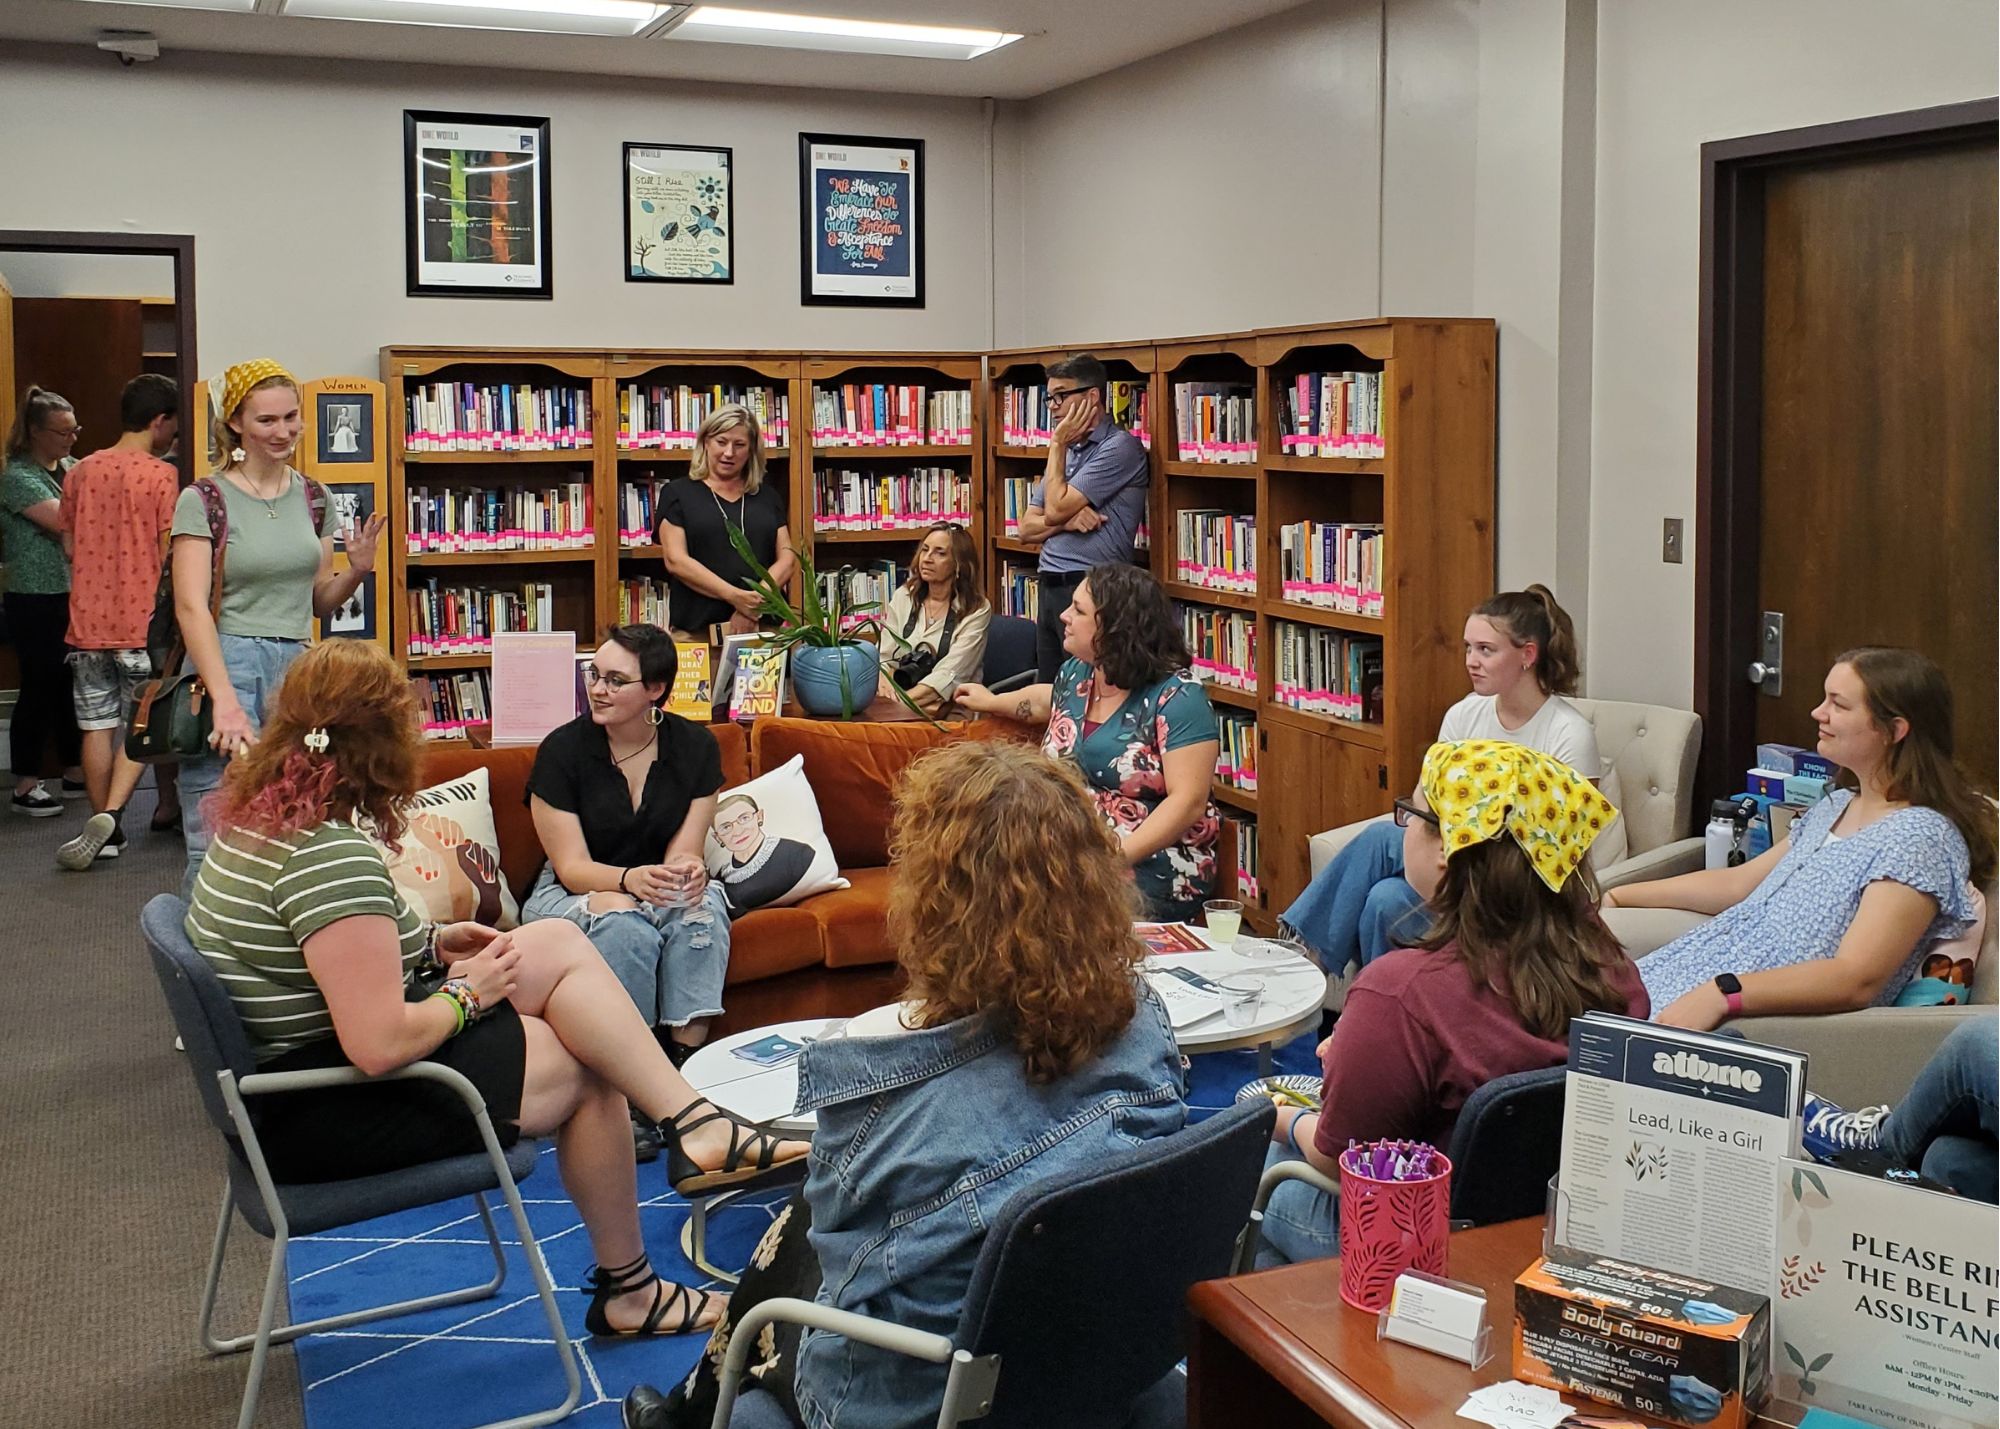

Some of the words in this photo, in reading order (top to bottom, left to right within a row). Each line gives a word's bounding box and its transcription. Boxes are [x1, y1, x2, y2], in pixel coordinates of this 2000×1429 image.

[436, 130, 459, 140] WORLD
[635, 176, 654, 185] Still
[829, 177, 850, 193] We
[850, 179, 880, 196] Have
[878, 181, 897, 196] To
[830, 190, 874, 208] Embrace
[874, 194, 898, 209] Our
[826, 204, 882, 221] Differences
[881, 207, 899, 221] To
[824, 217, 857, 232] Create
[857, 217, 902, 235] Freedom
[838, 231, 894, 249] Acceptance
[842, 245, 863, 260] For
[322, 379, 367, 390] WOMEN
[736, 674, 778, 692] BOY
[740, 698, 776, 713] AND
[1804, 763, 1826, 773] KNOW
[447, 782, 477, 801] UP
[1652, 1051, 1762, 1093] attune
[1629, 1107, 1673, 1133] Lead,
[1680, 1118, 1713, 1139] Like
[1719, 1131, 1727, 1143] a
[1733, 1131, 1762, 1151] Girl
[1852, 1232, 1954, 1276] PLEASE
[1965, 1261, 1999, 1288] RI
[1842, 1260, 1896, 1292] THE
[1907, 1277, 1976, 1313] BELL
[1639, 1302, 1662, 1315] 50
[1563, 1306, 1613, 1337] Body
[1619, 1322, 1681, 1350] Guard
[1559, 1328, 1625, 1352] SAFETY
[1629, 1349, 1679, 1368] GEAR
[1938, 1344, 1961, 1353] Center
[1963, 1350, 1980, 1359] Staff
[1913, 1360, 1937, 1371] Office
[1648, 1373, 1665, 1383] AZUL
[1911, 1371, 1931, 1382] 12PM
[1944, 1381, 1961, 1391] 1PM
[1569, 1377, 1625, 1405] FASTENAL
[1635, 1396, 1654, 1411] 50
[1908, 1381, 1940, 1397] Monday
[1948, 1392, 1974, 1407] Friday
[1847, 1400, 1866, 1410] TAKE
[1875, 1408, 1895, 1419] COPY
